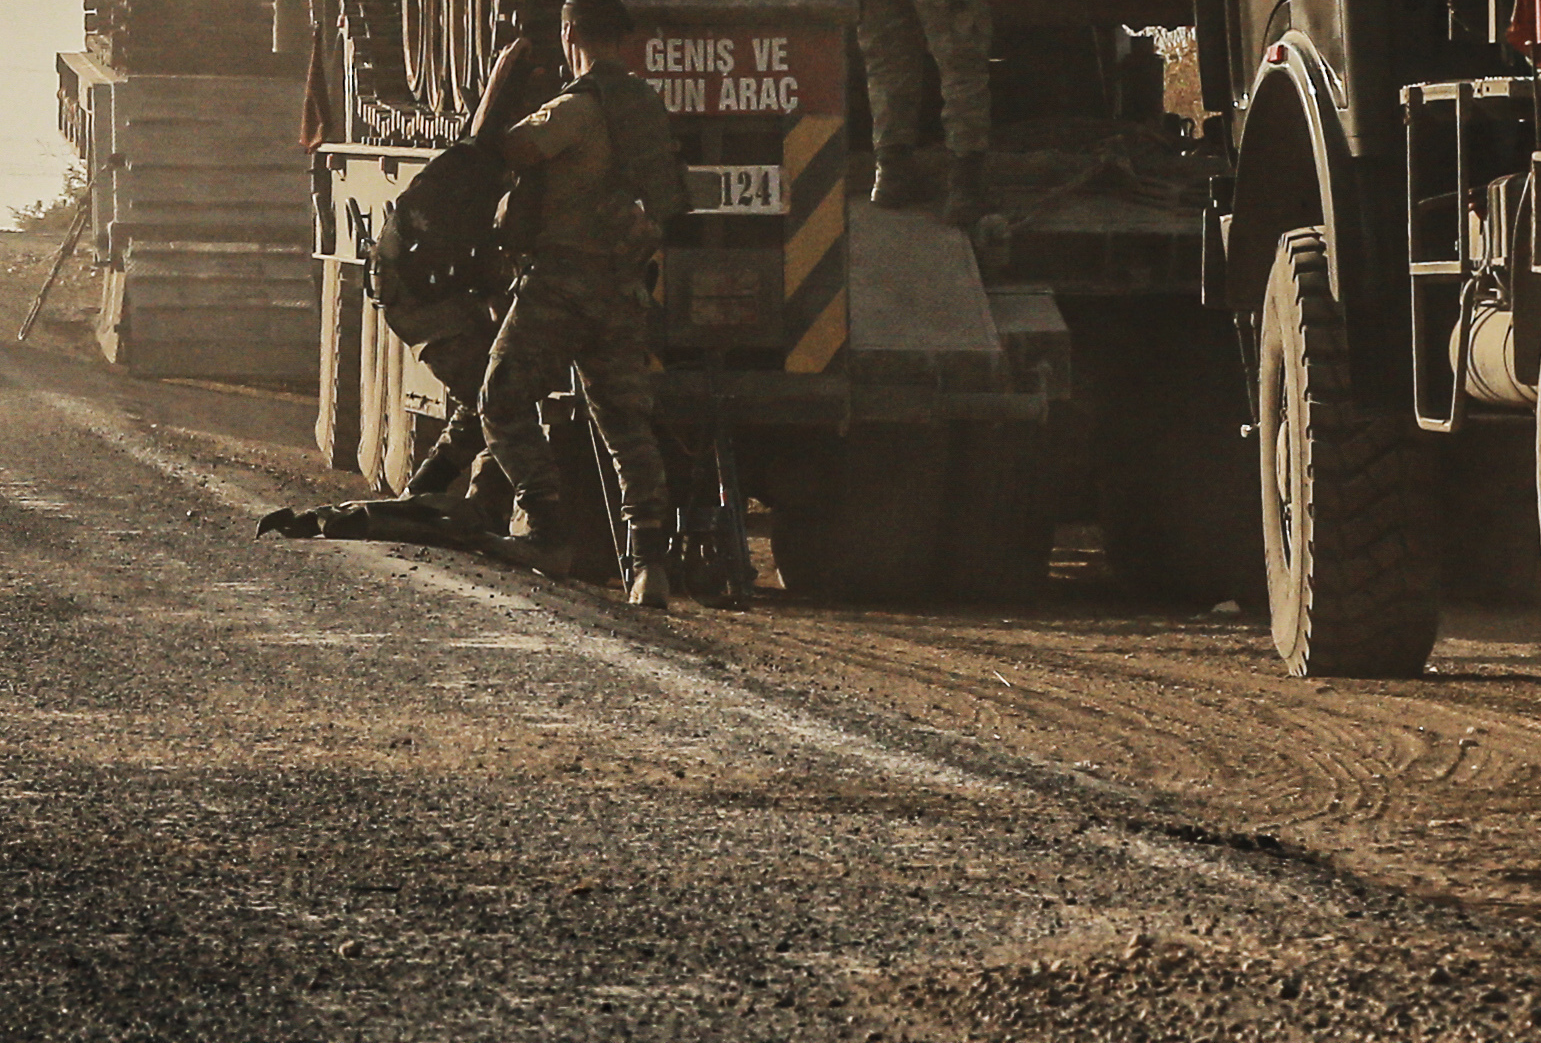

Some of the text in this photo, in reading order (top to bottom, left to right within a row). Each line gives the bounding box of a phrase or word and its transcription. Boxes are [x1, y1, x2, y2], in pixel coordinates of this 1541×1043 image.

[752, 37, 789, 71] VE
[718, 77, 799, 114] ARAÇ
[721, 171, 772, 206] 124
